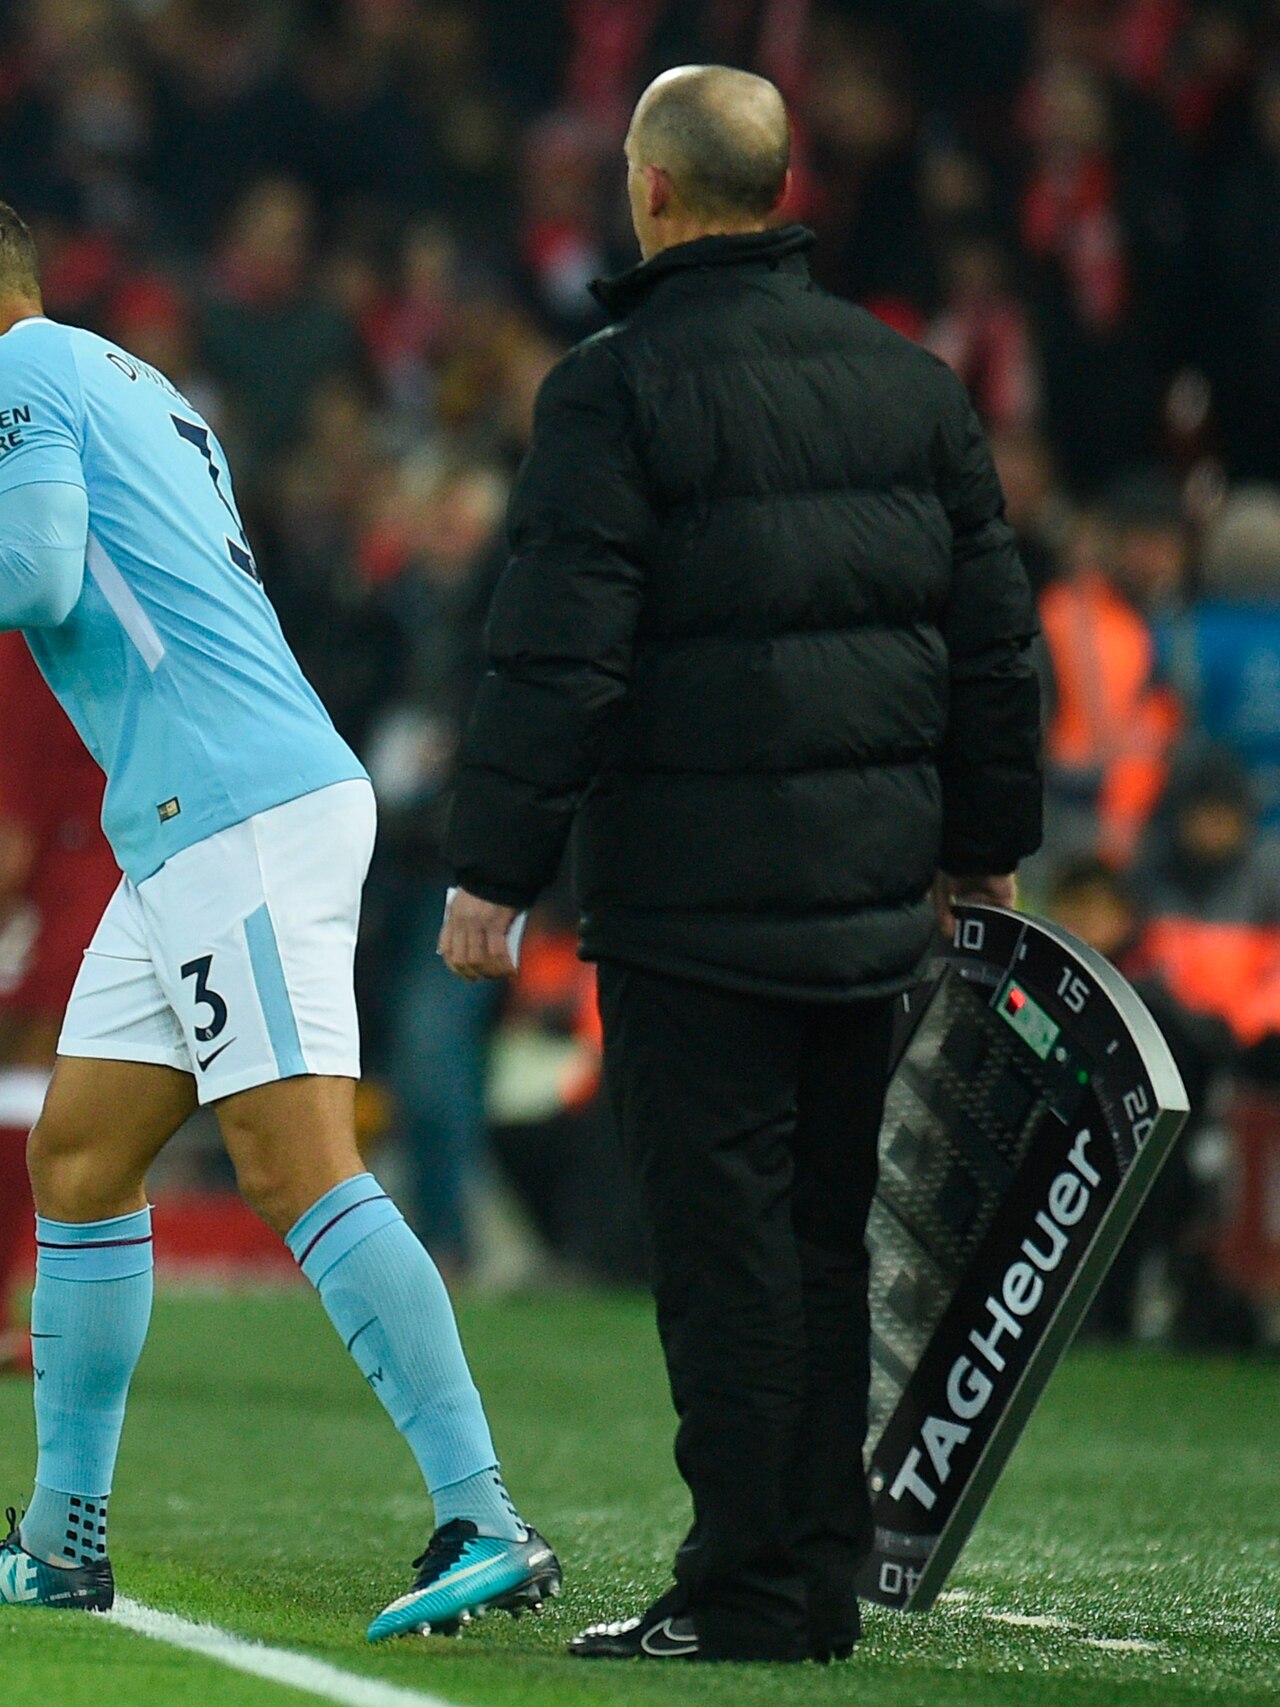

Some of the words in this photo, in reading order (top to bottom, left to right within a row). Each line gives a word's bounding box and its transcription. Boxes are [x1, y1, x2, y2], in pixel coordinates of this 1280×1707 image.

[953, 919, 985, 950] 10
[180, 953, 228, 1042] 3
[1056, 966, 1091, 1014] 15
